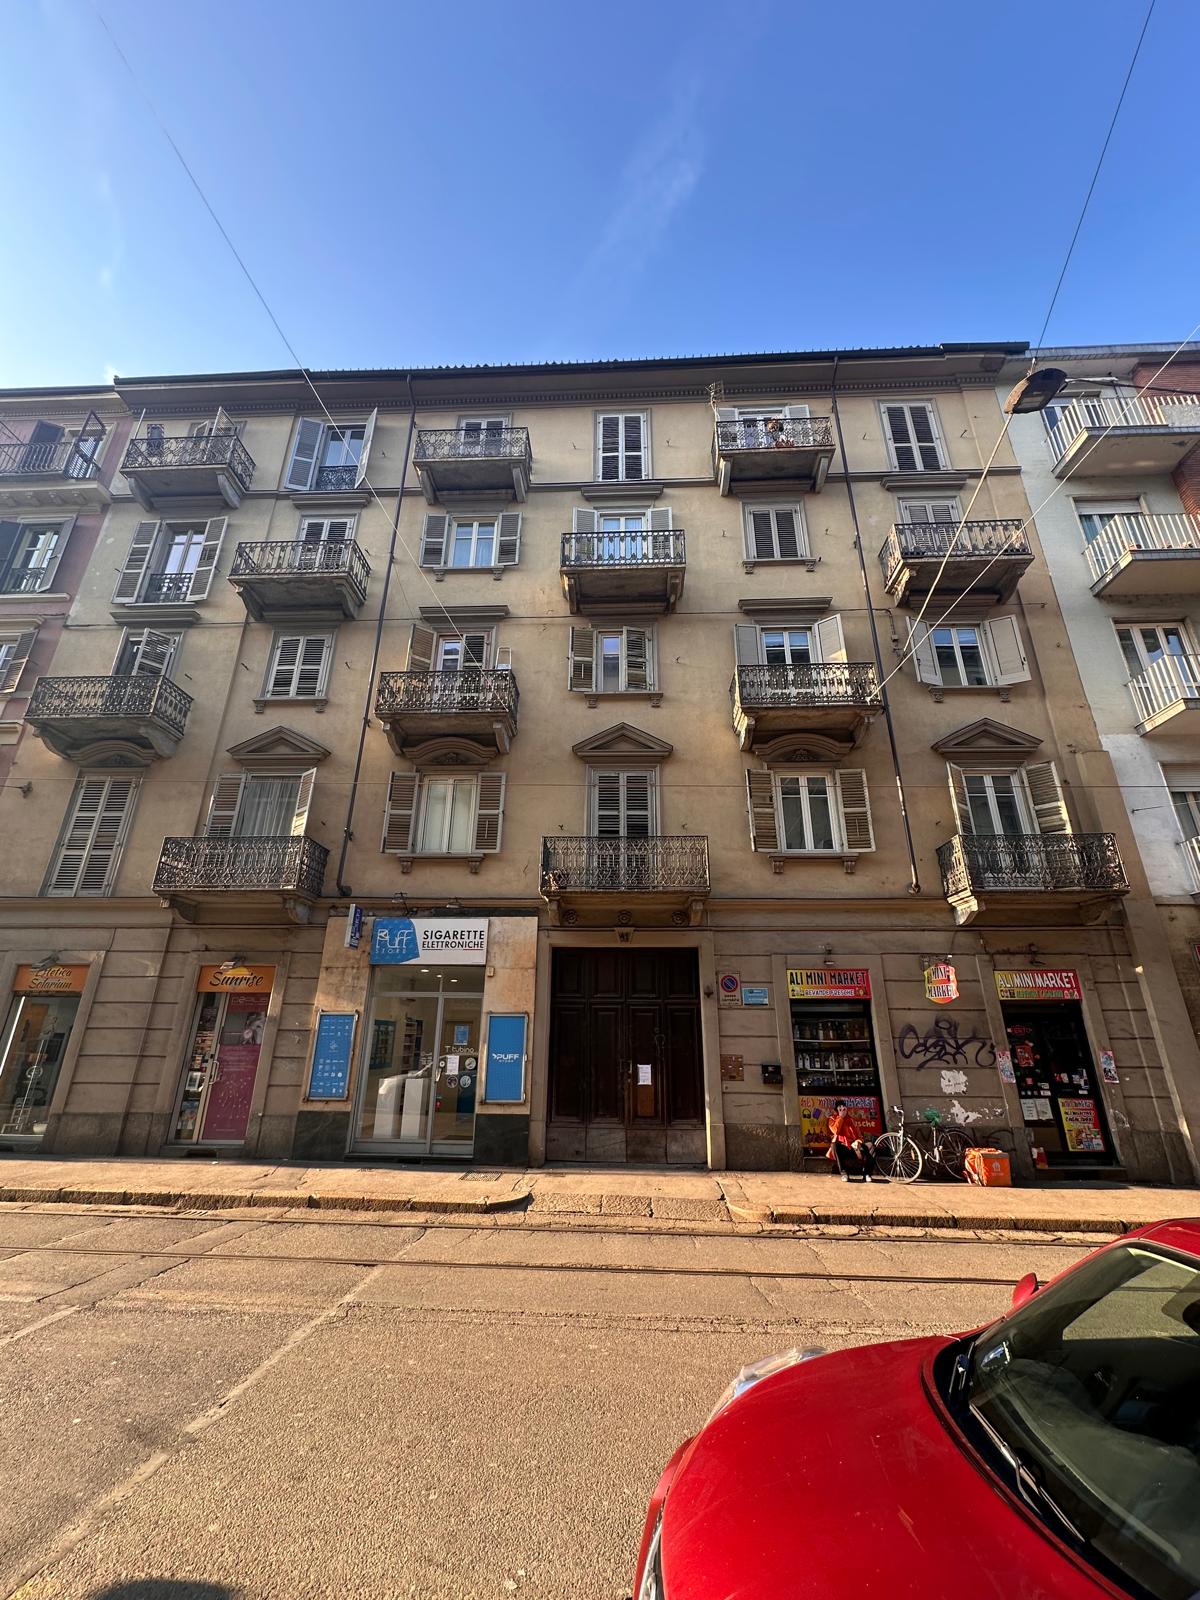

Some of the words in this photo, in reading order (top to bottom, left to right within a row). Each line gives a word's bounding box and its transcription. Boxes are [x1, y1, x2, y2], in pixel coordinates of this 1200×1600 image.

[422, 930, 485, 940] SIGARETTE
[421, 940, 485, 949] ELETTRONICHE
[28, 977, 73, 989] Solarium
[209, 971, 264, 987] Sunrise
[789, 971, 804, 986] ALI
[805, 971, 828, 985] MINI
[829, 971, 867, 986] MARKET
[999, 973, 1014, 988] ALI
[1013, 973, 1035, 988] MINI
[1034, 972, 1077, 988] MARKET
[496, 1053, 520, 1061] PUFF
